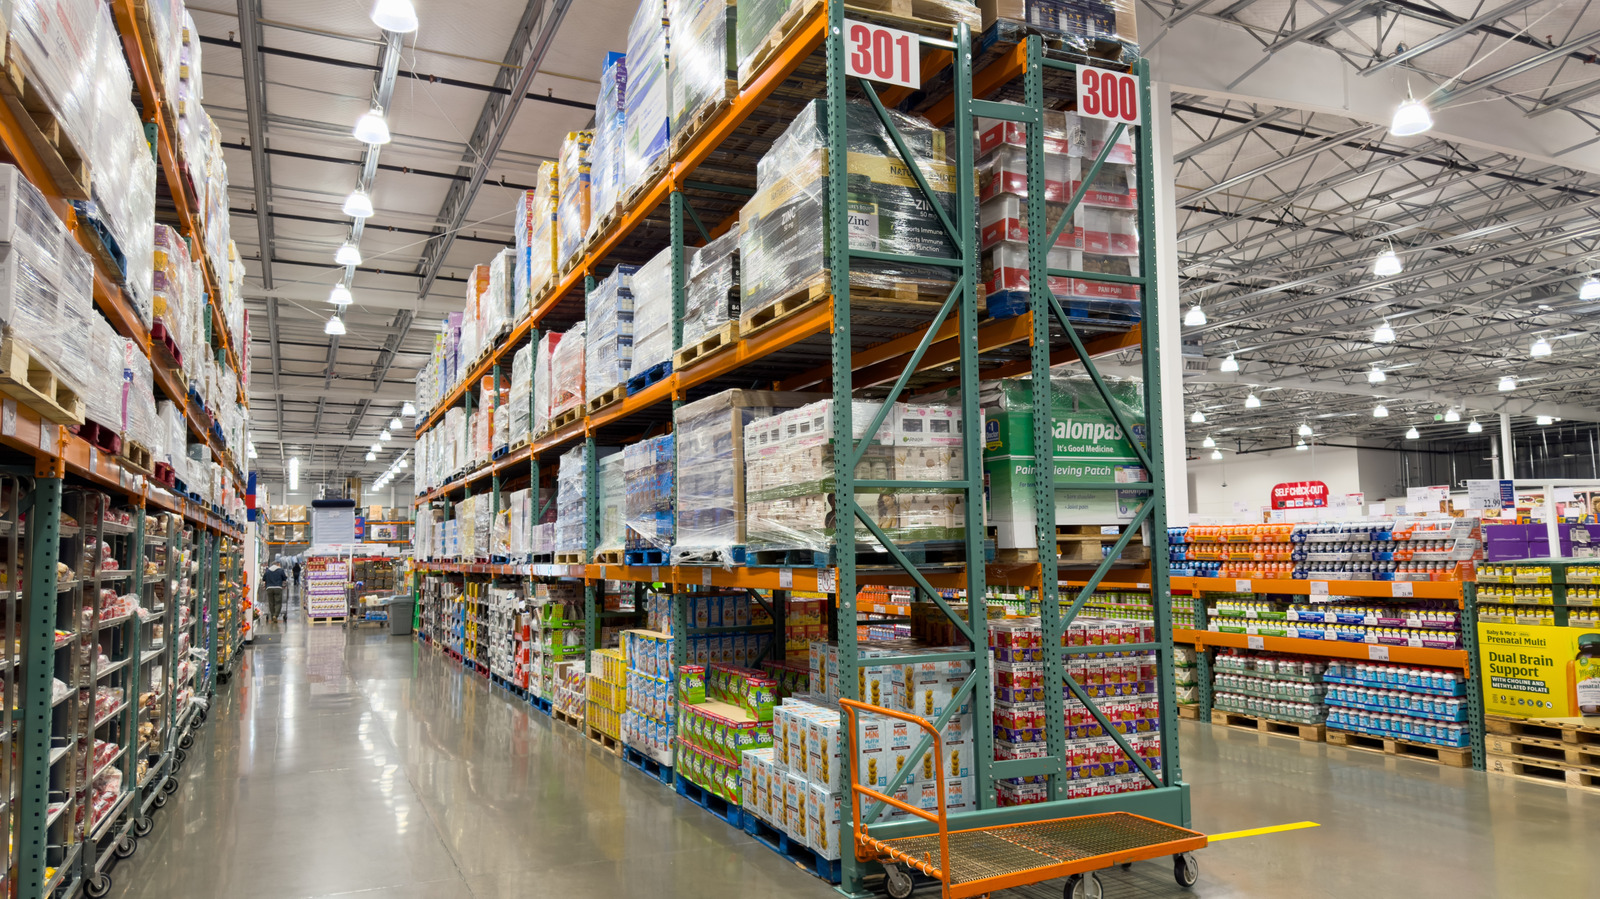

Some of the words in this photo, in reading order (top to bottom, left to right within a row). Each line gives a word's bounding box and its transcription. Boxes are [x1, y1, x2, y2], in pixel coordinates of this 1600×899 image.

[850, 25, 911, 83] 301
[1082, 69, 1138, 121] 300
[782, 206, 796, 226] ZINC
[848, 215, 870, 226] Zinc
[920, 228, 944, 236] Immune
[1054, 466, 1082, 477] ieving
[1084, 466, 1111, 476] Patch
[1275, 488, 1288, 497] SELF
[1290, 485, 1324, 496] CHECK-OUT
[1487, 636, 1522, 644] Prenatal
[1489, 652, 1516, 663] Dual
[1520, 654, 1553, 666] Brain
[1490, 664, 1539, 677] Support
